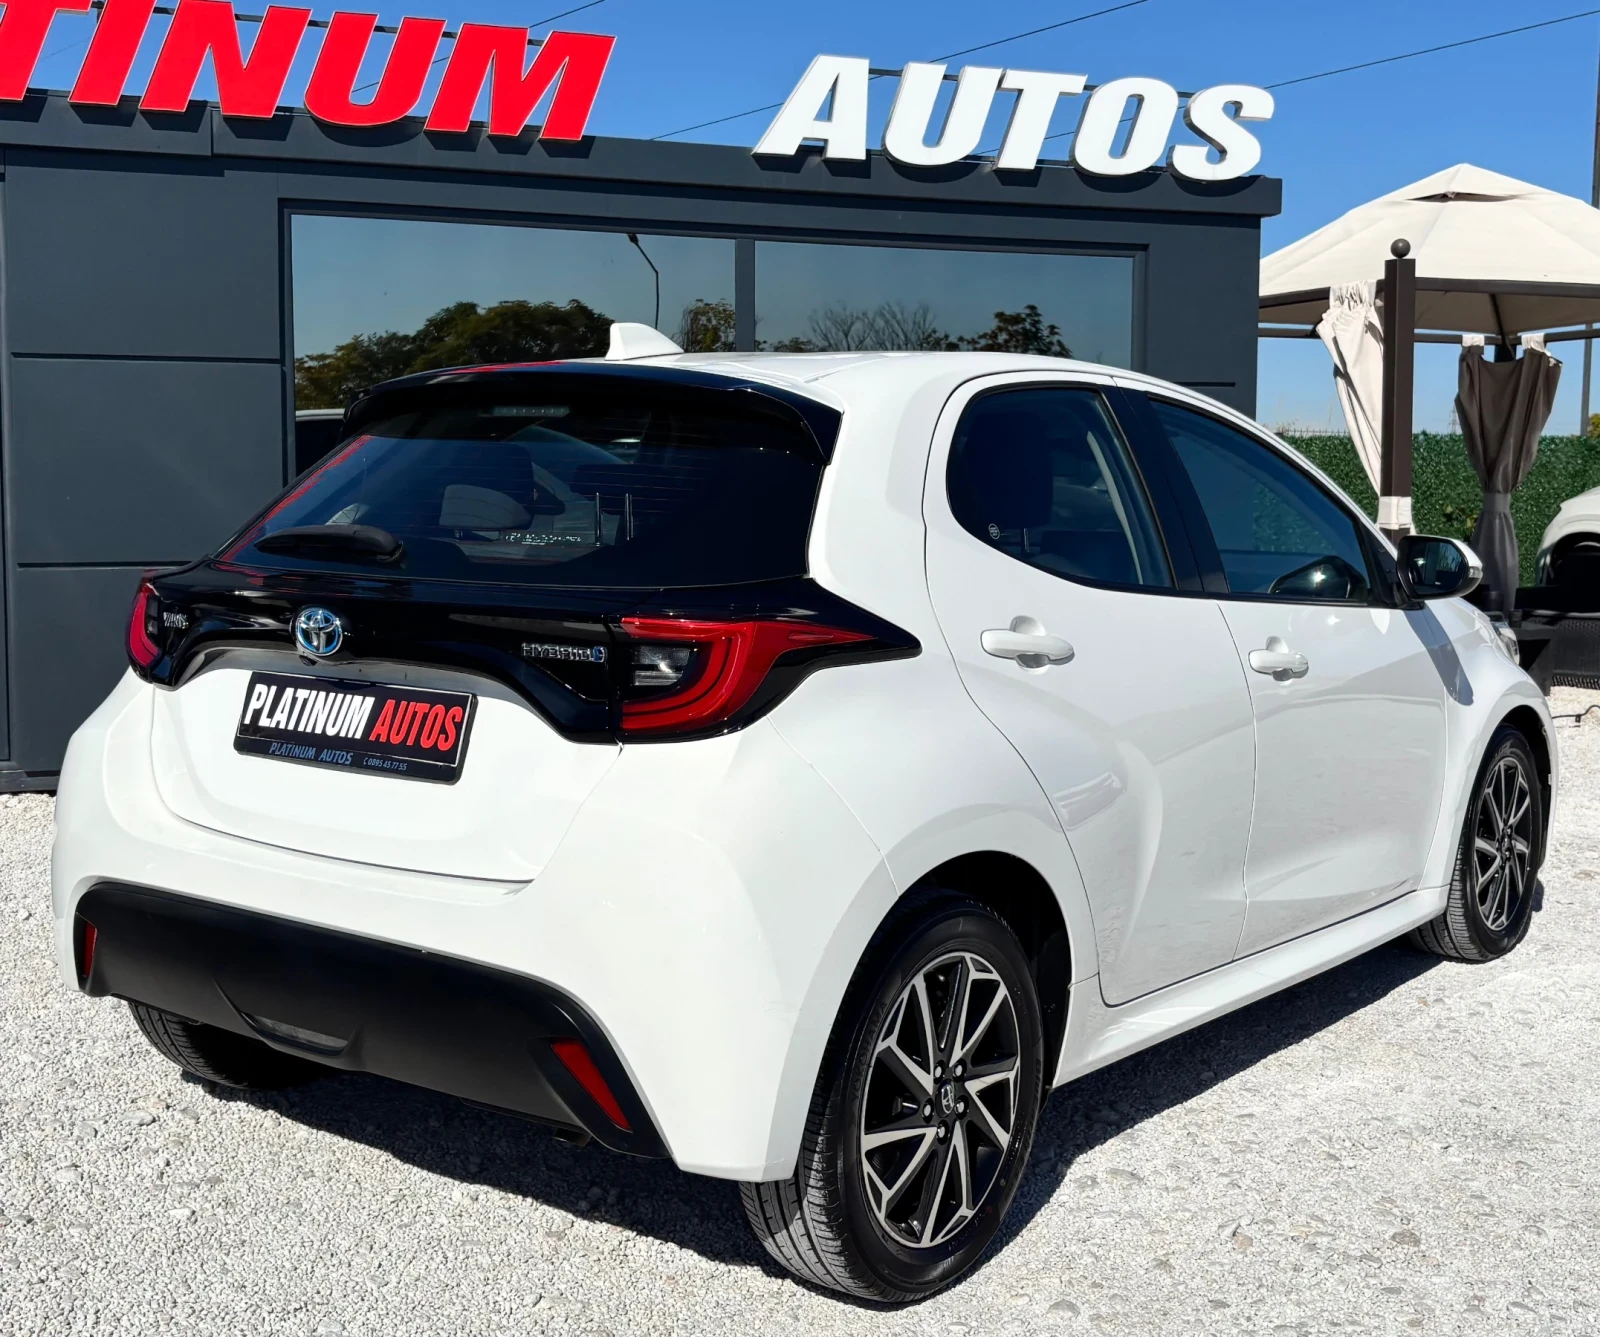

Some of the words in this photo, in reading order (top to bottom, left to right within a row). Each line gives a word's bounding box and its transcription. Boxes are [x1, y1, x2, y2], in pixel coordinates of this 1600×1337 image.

[752, 54, 1275, 181] AUTOS
[521, 642, 594, 661] HYBRID
[244, 683, 375, 739] PLATINUM
[369, 700, 464, 752] AUTOS
[269, 742, 316, 760] PLATINUM
[318, 749, 353, 765] AUTOS
[367, 758, 383, 767] 0895
[383, 760, 392, 768] 45
[851, 1002, 888, 1102] YOKOHAMA
